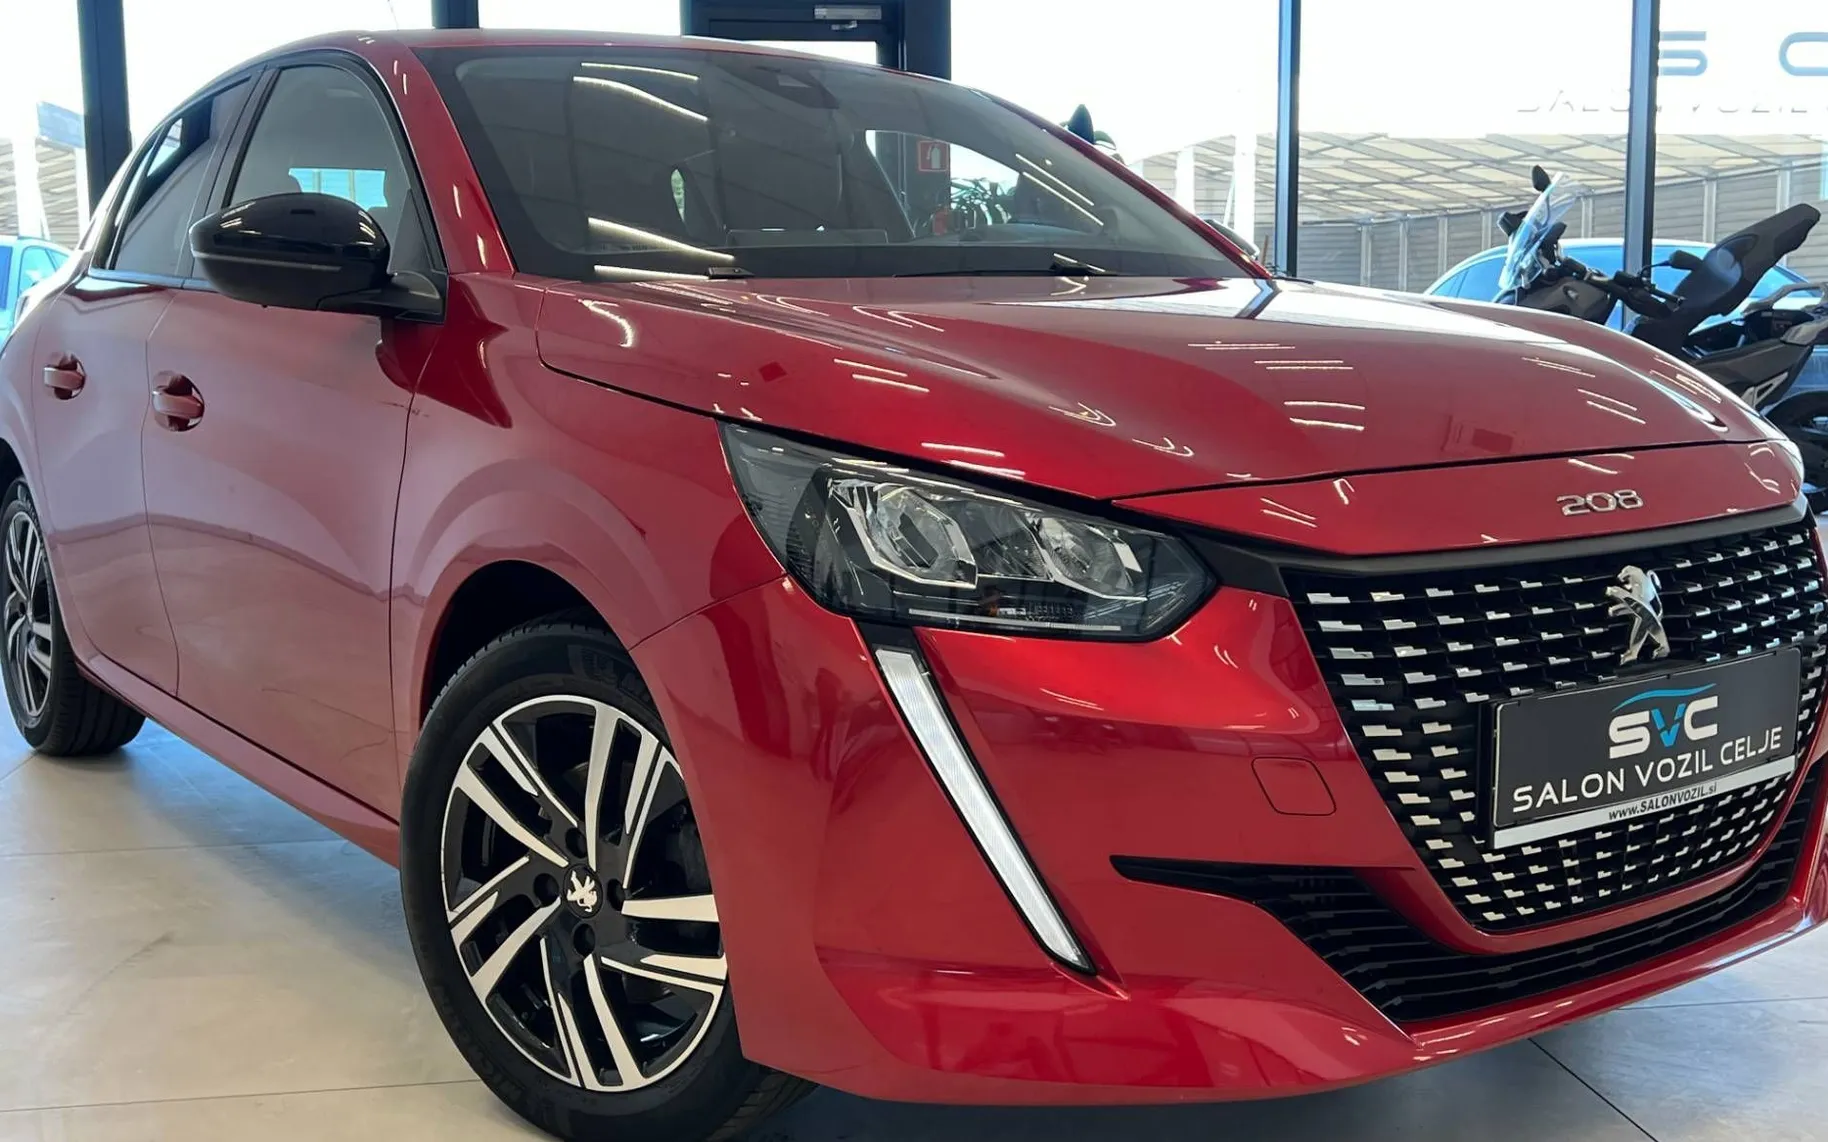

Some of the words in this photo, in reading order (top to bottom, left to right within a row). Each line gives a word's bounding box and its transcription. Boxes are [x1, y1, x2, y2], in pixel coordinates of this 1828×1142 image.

[1556, 488, 1644, 516] 208
[1609, 696, 1719, 759] SVC
[1513, 768, 1625, 812] SALON
[1635, 749, 1713, 787] VOZIL
[1720, 726, 1783, 765] CELJE
[1608, 782, 1717, 820] www.SALONVOZIL.si
